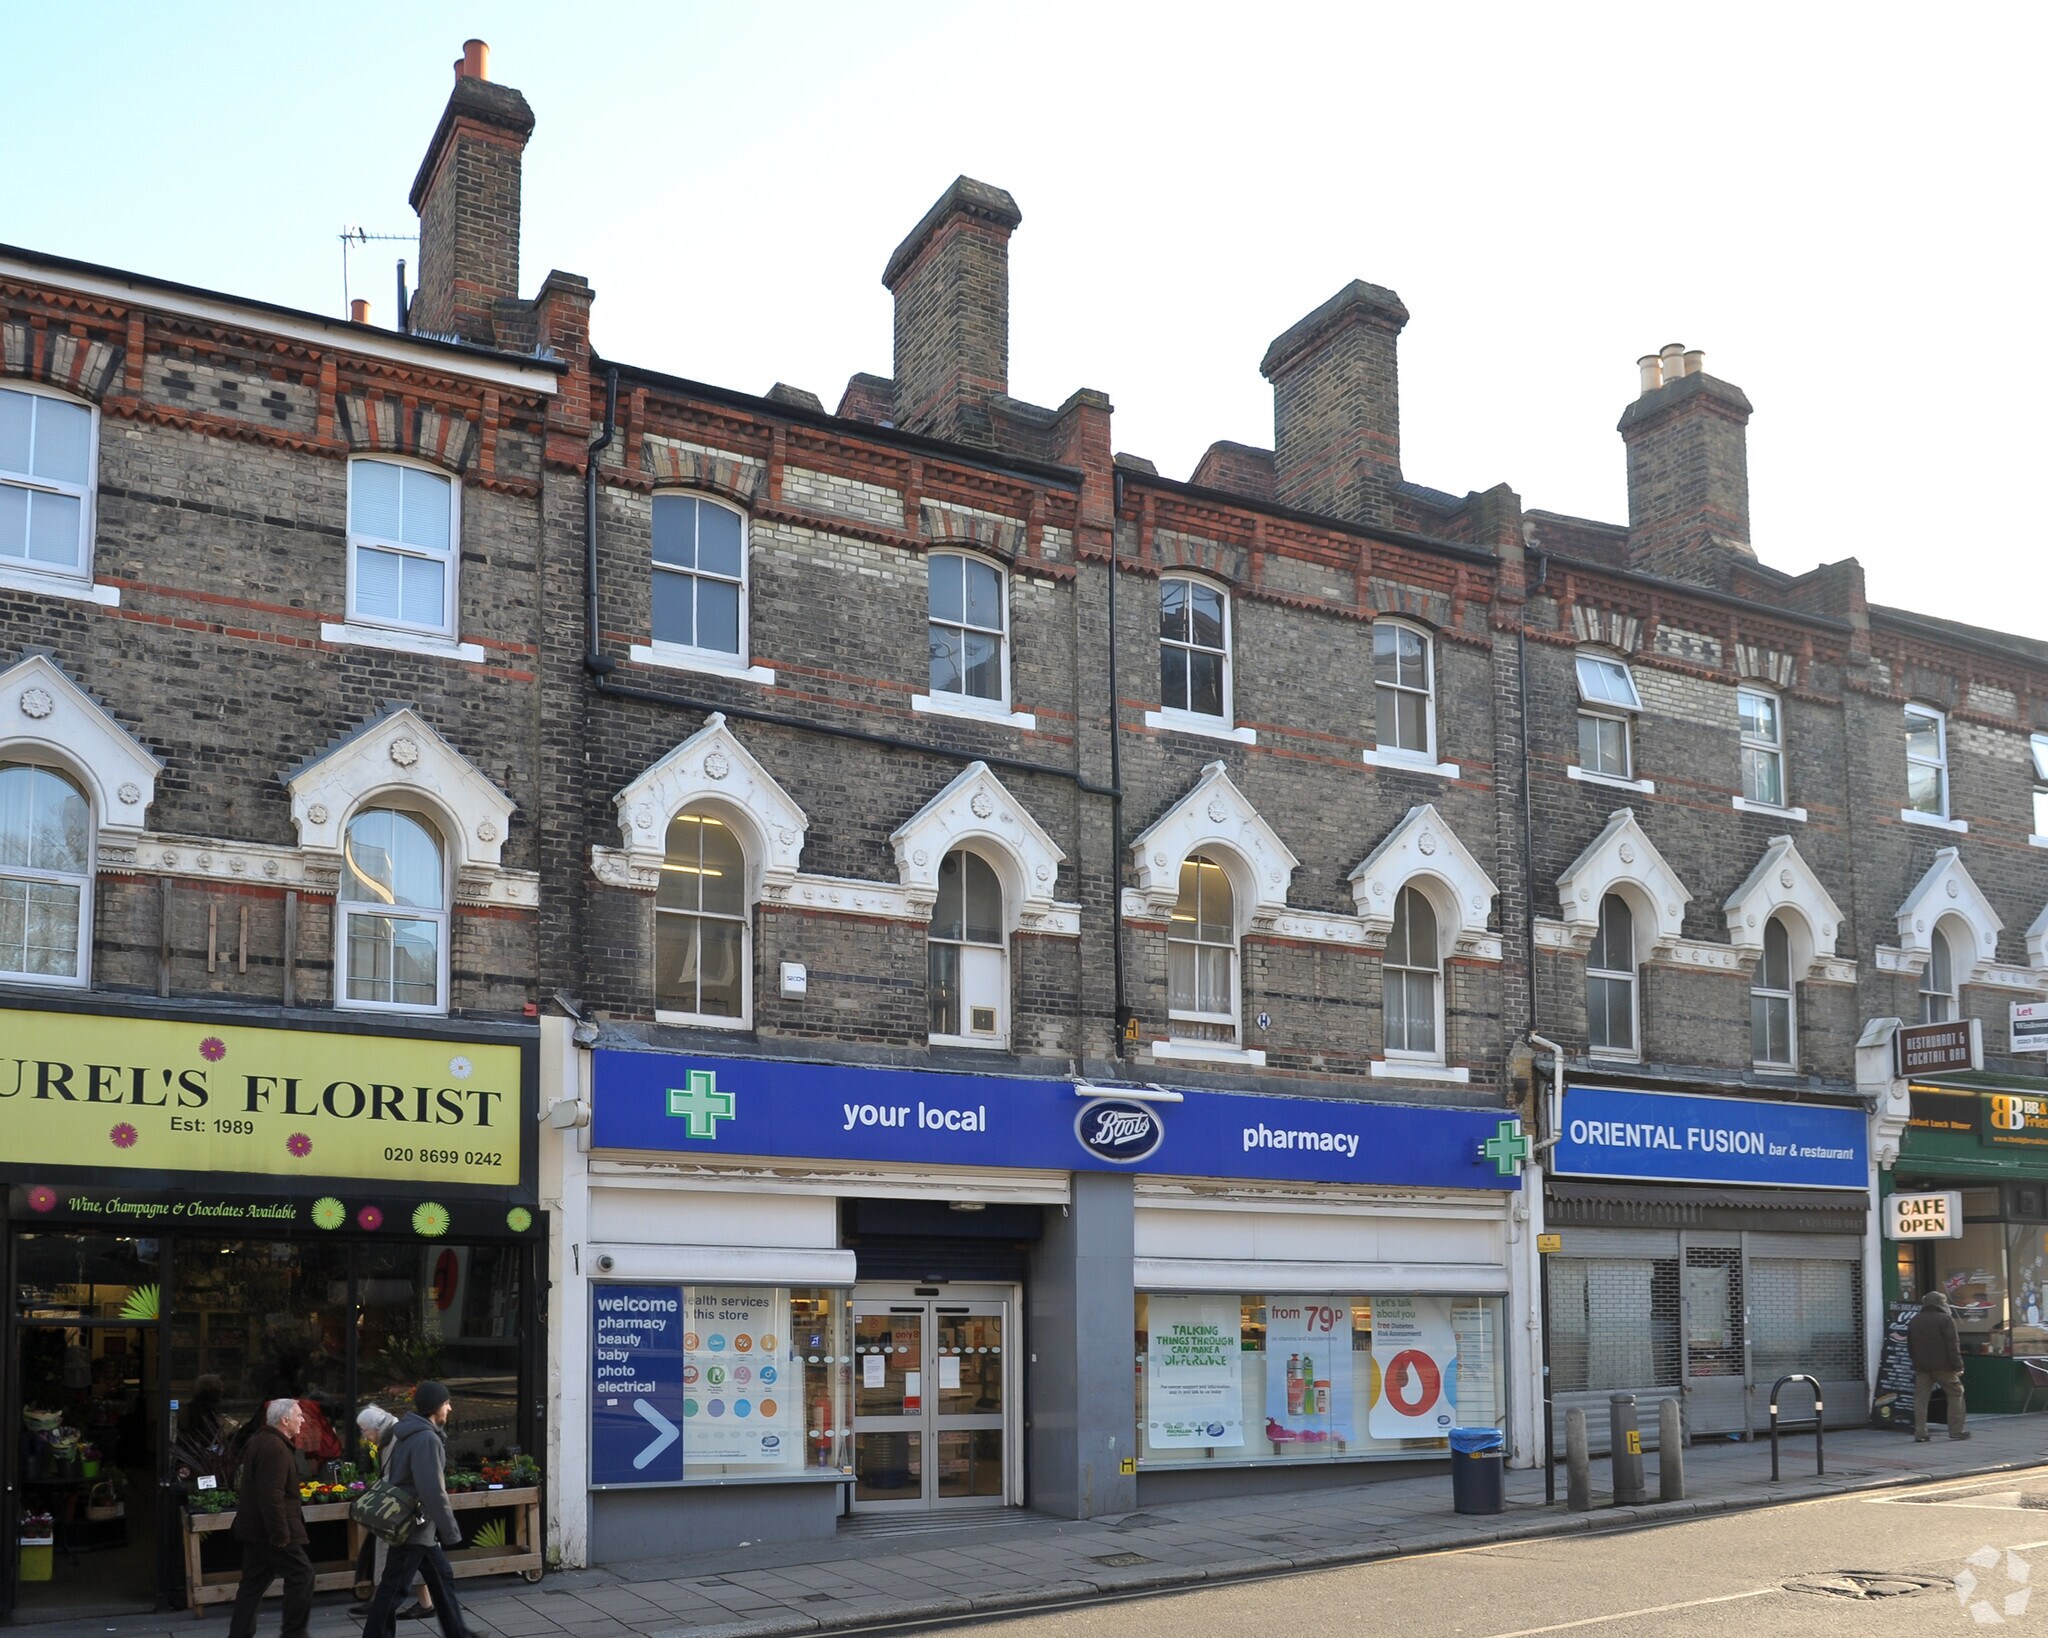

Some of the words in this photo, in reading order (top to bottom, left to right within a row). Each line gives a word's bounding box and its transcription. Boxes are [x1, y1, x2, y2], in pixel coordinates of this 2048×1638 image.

[2016, 1007, 2033, 1017] Let
[1260, 1014, 1268, 1027] H
[1959, 1031, 1965, 1045] &
[1907, 1049, 1947, 1066] COCKTAIL
[1949, 1047, 1966, 1062] BAR
[241, 1074, 503, 1127] FLORIST
[843, 1103, 911, 1131] your
[918, 1101, 986, 1132] local
[169, 1116, 206, 1133] Est:
[212, 1119, 254, 1135] 1989
[1089, 1109, 1151, 1146] Boots
[1243, 1123, 1360, 1158] pharmacy
[1569, 1119, 1682, 1150] ORIENTAL
[1687, 1127, 1765, 1155] FUSION
[1768, 1142, 1787, 1156] bar
[1790, 1143, 1797, 1157] &
[1800, 1145, 1854, 1160] restaurant
[384, 1147, 413, 1162] 020
[419, 1149, 459, 1164] 8699
[464, 1151, 502, 1166] 0242
[68, 1197, 102, 1214] Wine,
[105, 1198, 169, 1219] Champagne
[172, 1202, 185, 1215] &
[187, 1200, 244, 1217] Chocolates
[246, 1203, 297, 1219] Available
[1897, 1198, 1946, 1216] CAFE
[1899, 1218, 1945, 1233] OPEN
[597, 1296, 678, 1313] welcome
[721, 1297, 769, 1307] services
[693, 1309, 715, 1320] this
[718, 1310, 749, 1321] store
[1271, 1305, 1300, 1319] from
[1304, 1305, 1343, 1332] 79p
[1376, 1309, 1400, 1319] about
[1401, 1311, 1416, 1321] you
[597, 1317, 667, 1332] pharmacy
[1172, 1325, 1219, 1336] TALKING
[597, 1333, 641, 1347] beauty
[895, 1330, 912, 1340] only
[1156, 1336, 1190, 1346] THINGS
[1191, 1337, 1234, 1346] THROUGH
[597, 1349, 629, 1363] baby
[1171, 1346, 1190, 1354] CAN
[1191, 1346, 1213, 1354] MAKE
[1214, 1346, 1220, 1354] A
[597, 1365, 636, 1379] photo
[597, 1381, 656, 1393] electrical
[1124, 1456, 1137, 1472] H
